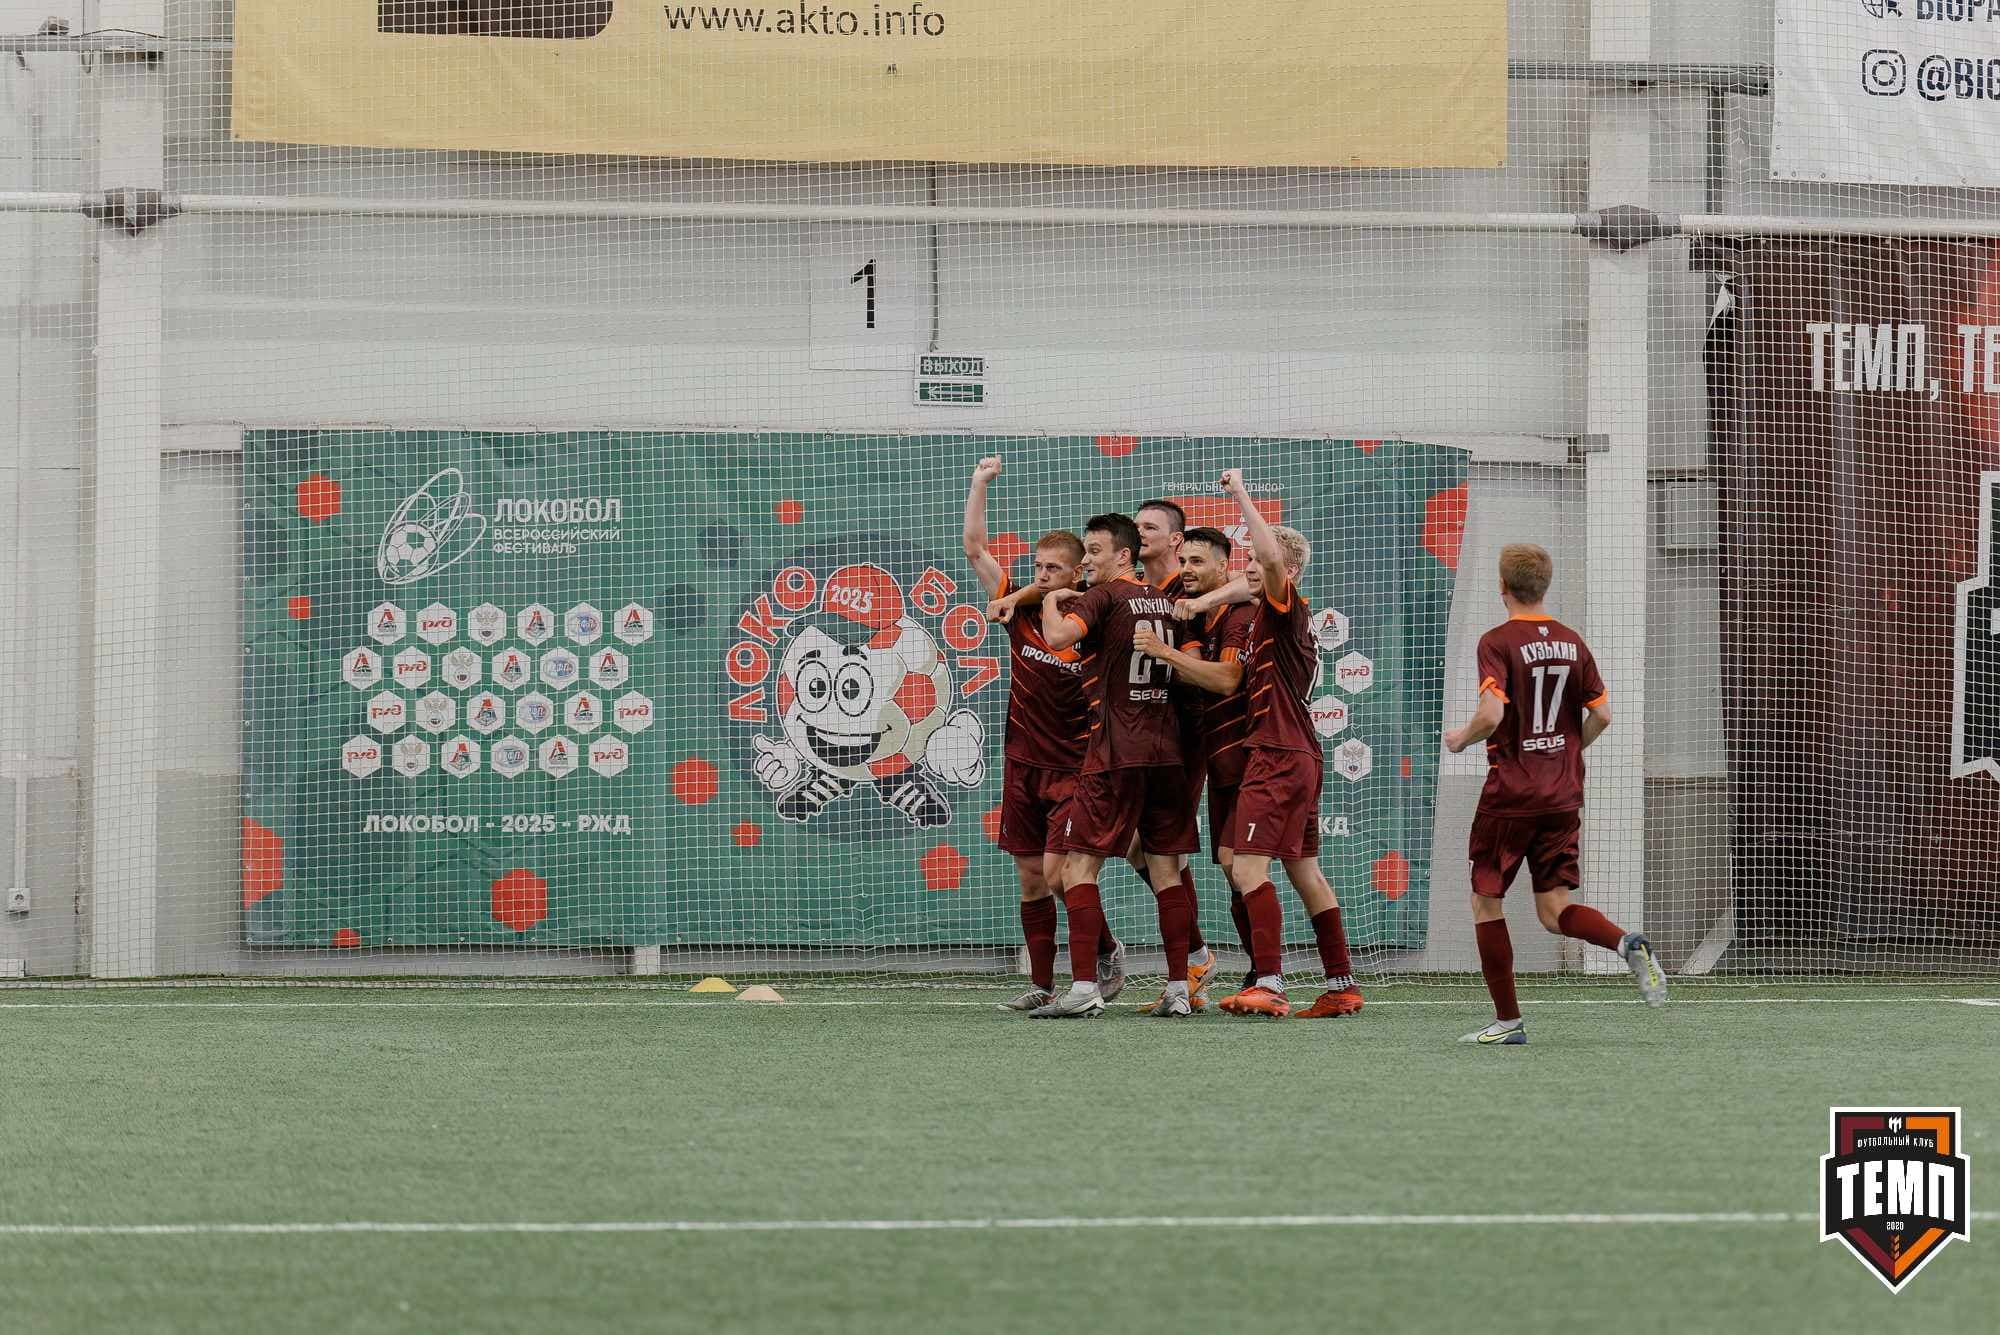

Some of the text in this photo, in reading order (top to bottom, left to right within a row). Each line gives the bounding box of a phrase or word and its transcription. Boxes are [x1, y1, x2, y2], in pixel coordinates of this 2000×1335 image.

[664, 1, 945, 36] www.akto.info
[851, 258, 876, 328] 1
[922, 359, 983, 374] ВЫХОД
[1806, 323, 1940, 401] ТЕМП,
[1163, 481, 1285, 493] ГЕНЕРАЛЬН ПОНСОР
[494, 498, 621, 523] ЛОКОБОЛ
[494, 526, 621, 541] ВСЕРОССИЙСКИЙ
[492, 542, 577, 554] ФЕСТИВАЛЬ
[831, 585, 874, 613] 2025
[1520, 641, 1577, 664] КУЗЬКИН
[1129, 688, 1168, 700] SEUS
[1532, 665, 1570, 734] 17
[1522, 734, 1565, 751] SEUS
[363, 815, 479, 833] ЛОКОБОЛ
[501, 815, 556, 832] 2025
[577, 815, 631, 835] РЖД
[1247, 823, 1256, 842] 7
[1318, 816, 1349, 837] ЖД
